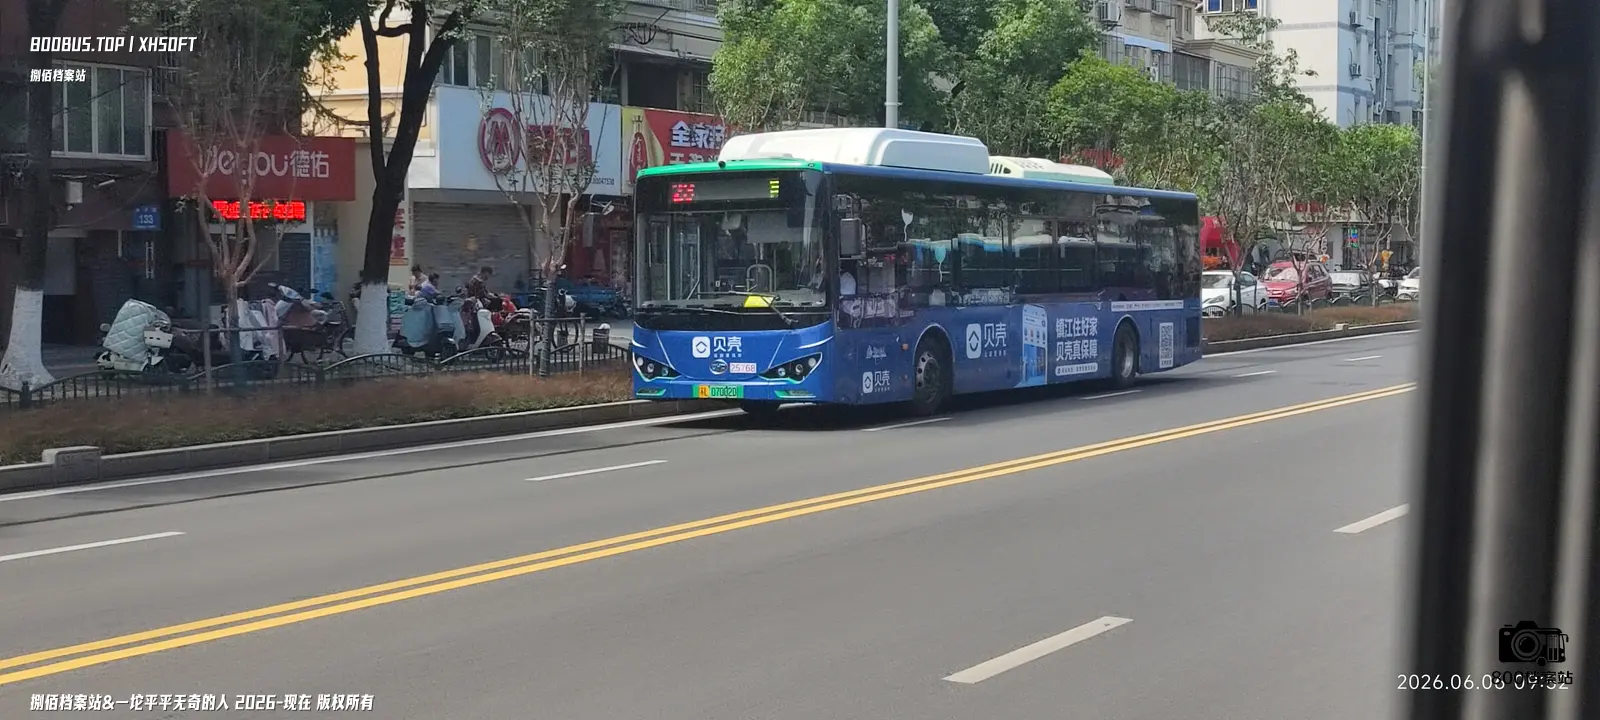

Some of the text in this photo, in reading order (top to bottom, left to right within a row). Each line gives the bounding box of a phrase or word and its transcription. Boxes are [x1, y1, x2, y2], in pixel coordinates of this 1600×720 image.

[984, 322, 1007, 348] 贝壳
[1055, 316, 1098, 338] 镇江住好家
[713, 336, 742, 353] 贝壳
[1055, 338, 1098, 361] 贝壳真保障
[730, 363, 756, 372] 25768
[874, 370, 890, 387] 贝壳
